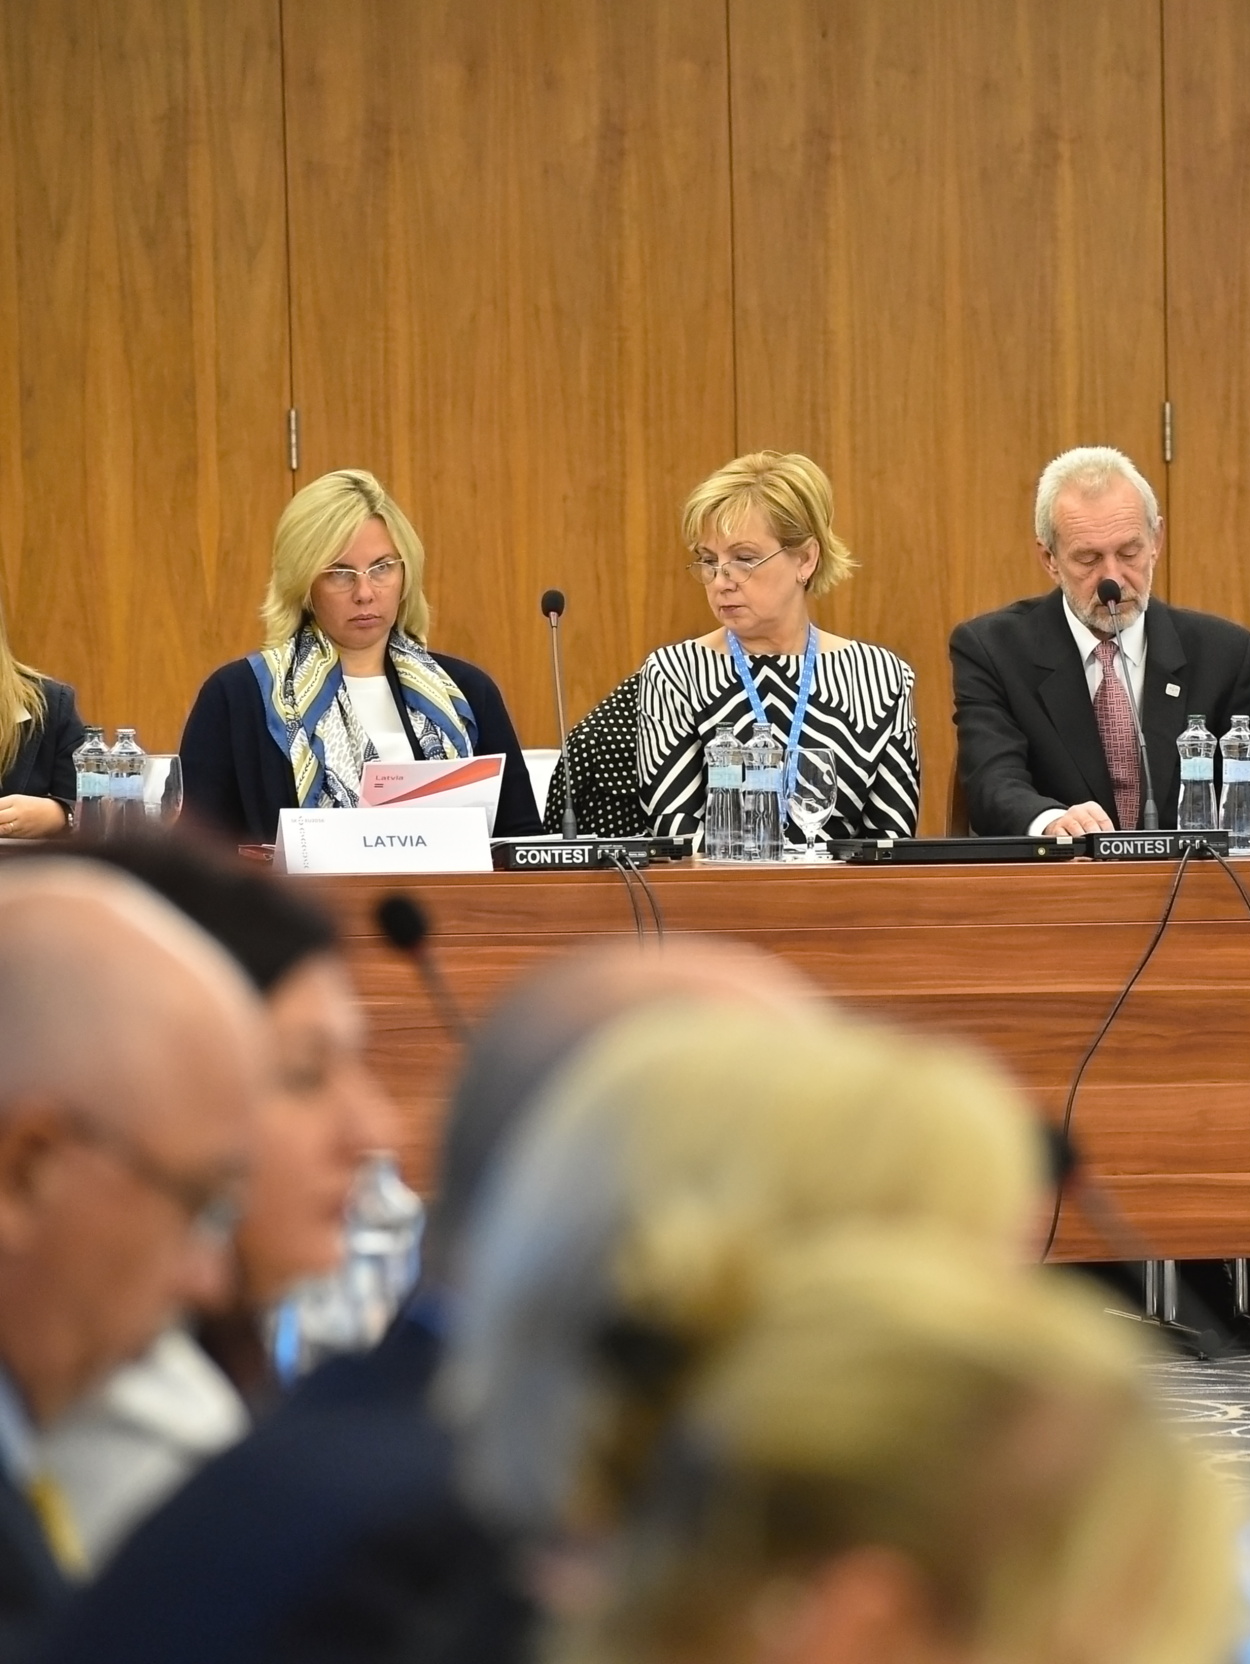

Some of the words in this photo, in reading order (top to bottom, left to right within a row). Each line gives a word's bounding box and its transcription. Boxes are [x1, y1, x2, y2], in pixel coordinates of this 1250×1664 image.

[362, 834, 428, 848] LATVIA
[1099, 836, 1174, 855] CONTEST
[515, 845, 593, 864] CONTEST
